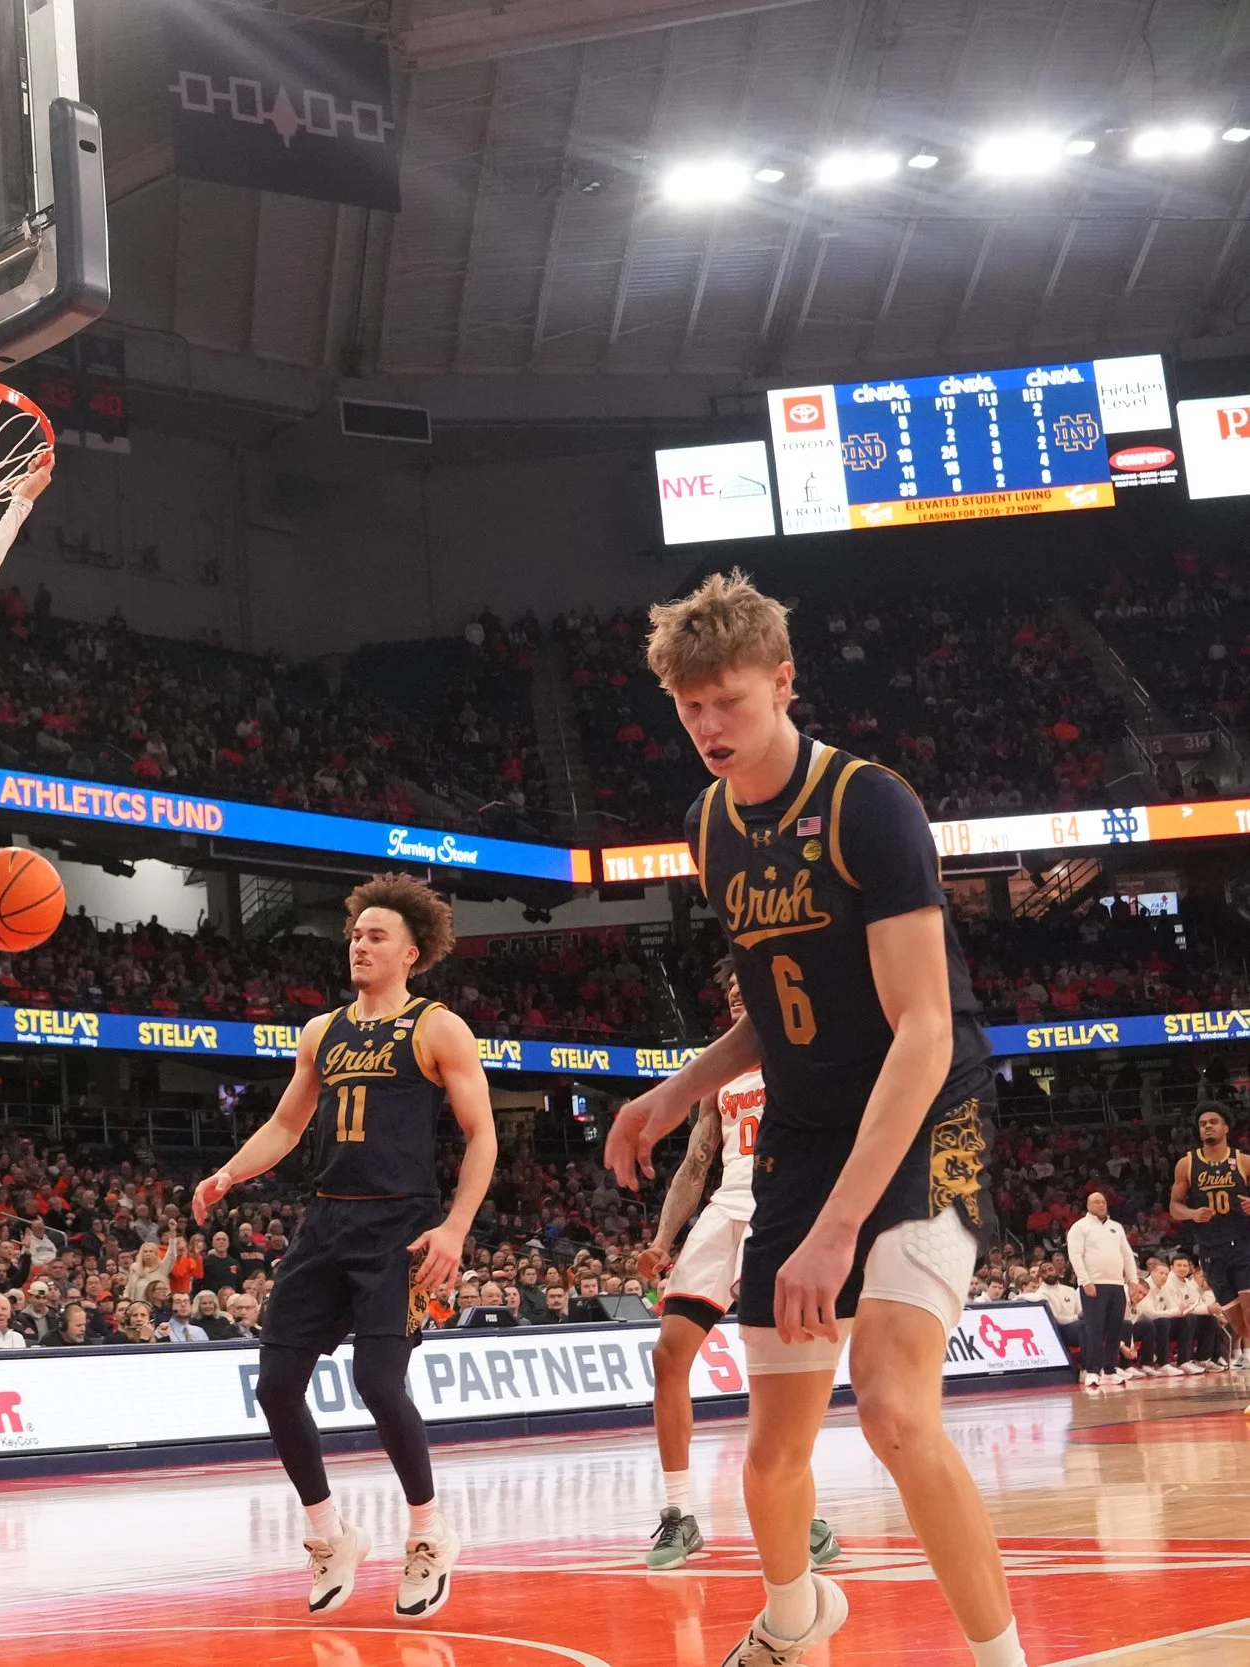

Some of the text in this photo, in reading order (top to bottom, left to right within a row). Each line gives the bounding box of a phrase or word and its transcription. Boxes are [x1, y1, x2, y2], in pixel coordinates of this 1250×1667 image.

[1101, 382, 1162, 396] Hidden
[1032, 403, 1042, 417] 2
[782, 440, 835, 451] TOYOTA
[662, 475, 715, 499] NYE
[905, 490, 1052, 511] ELEVATED STUDENT LIVING
[918, 510, 956, 522] LEASING
[958, 508, 976, 519] FOR
[1017, 503, 1042, 514] NOW!
[0, 775, 147, 822] ATHLETICS
[152, 796, 223, 832] FUND
[1051, 813, 1080, 845] 64
[387, 828, 478, 864] Turning Stone
[725, 866, 832, 949] Irish
[771, 955, 817, 1045] 6
[14, 1008, 99, 1036] STELLAR
[138, 1022, 217, 1049] STELLAR
[253, 1024, 301, 1048] STELL
[1026, 1023, 1119, 1048] STELLAR
[321, 1039, 397, 1084] Irish
[477, 1038, 521, 1061] ELLAR
[550, 1047, 610, 1071] STELLAR
[336, 1085, 367, 1142] 11
[721, 1088, 766, 1119] Syrac
[739, 1115, 760, 1156] 0
[1197, 1169, 1236, 1190] Irish
[1205, 1190, 1230, 1215] 10
[424, 1343, 633, 1406] PARTNER
